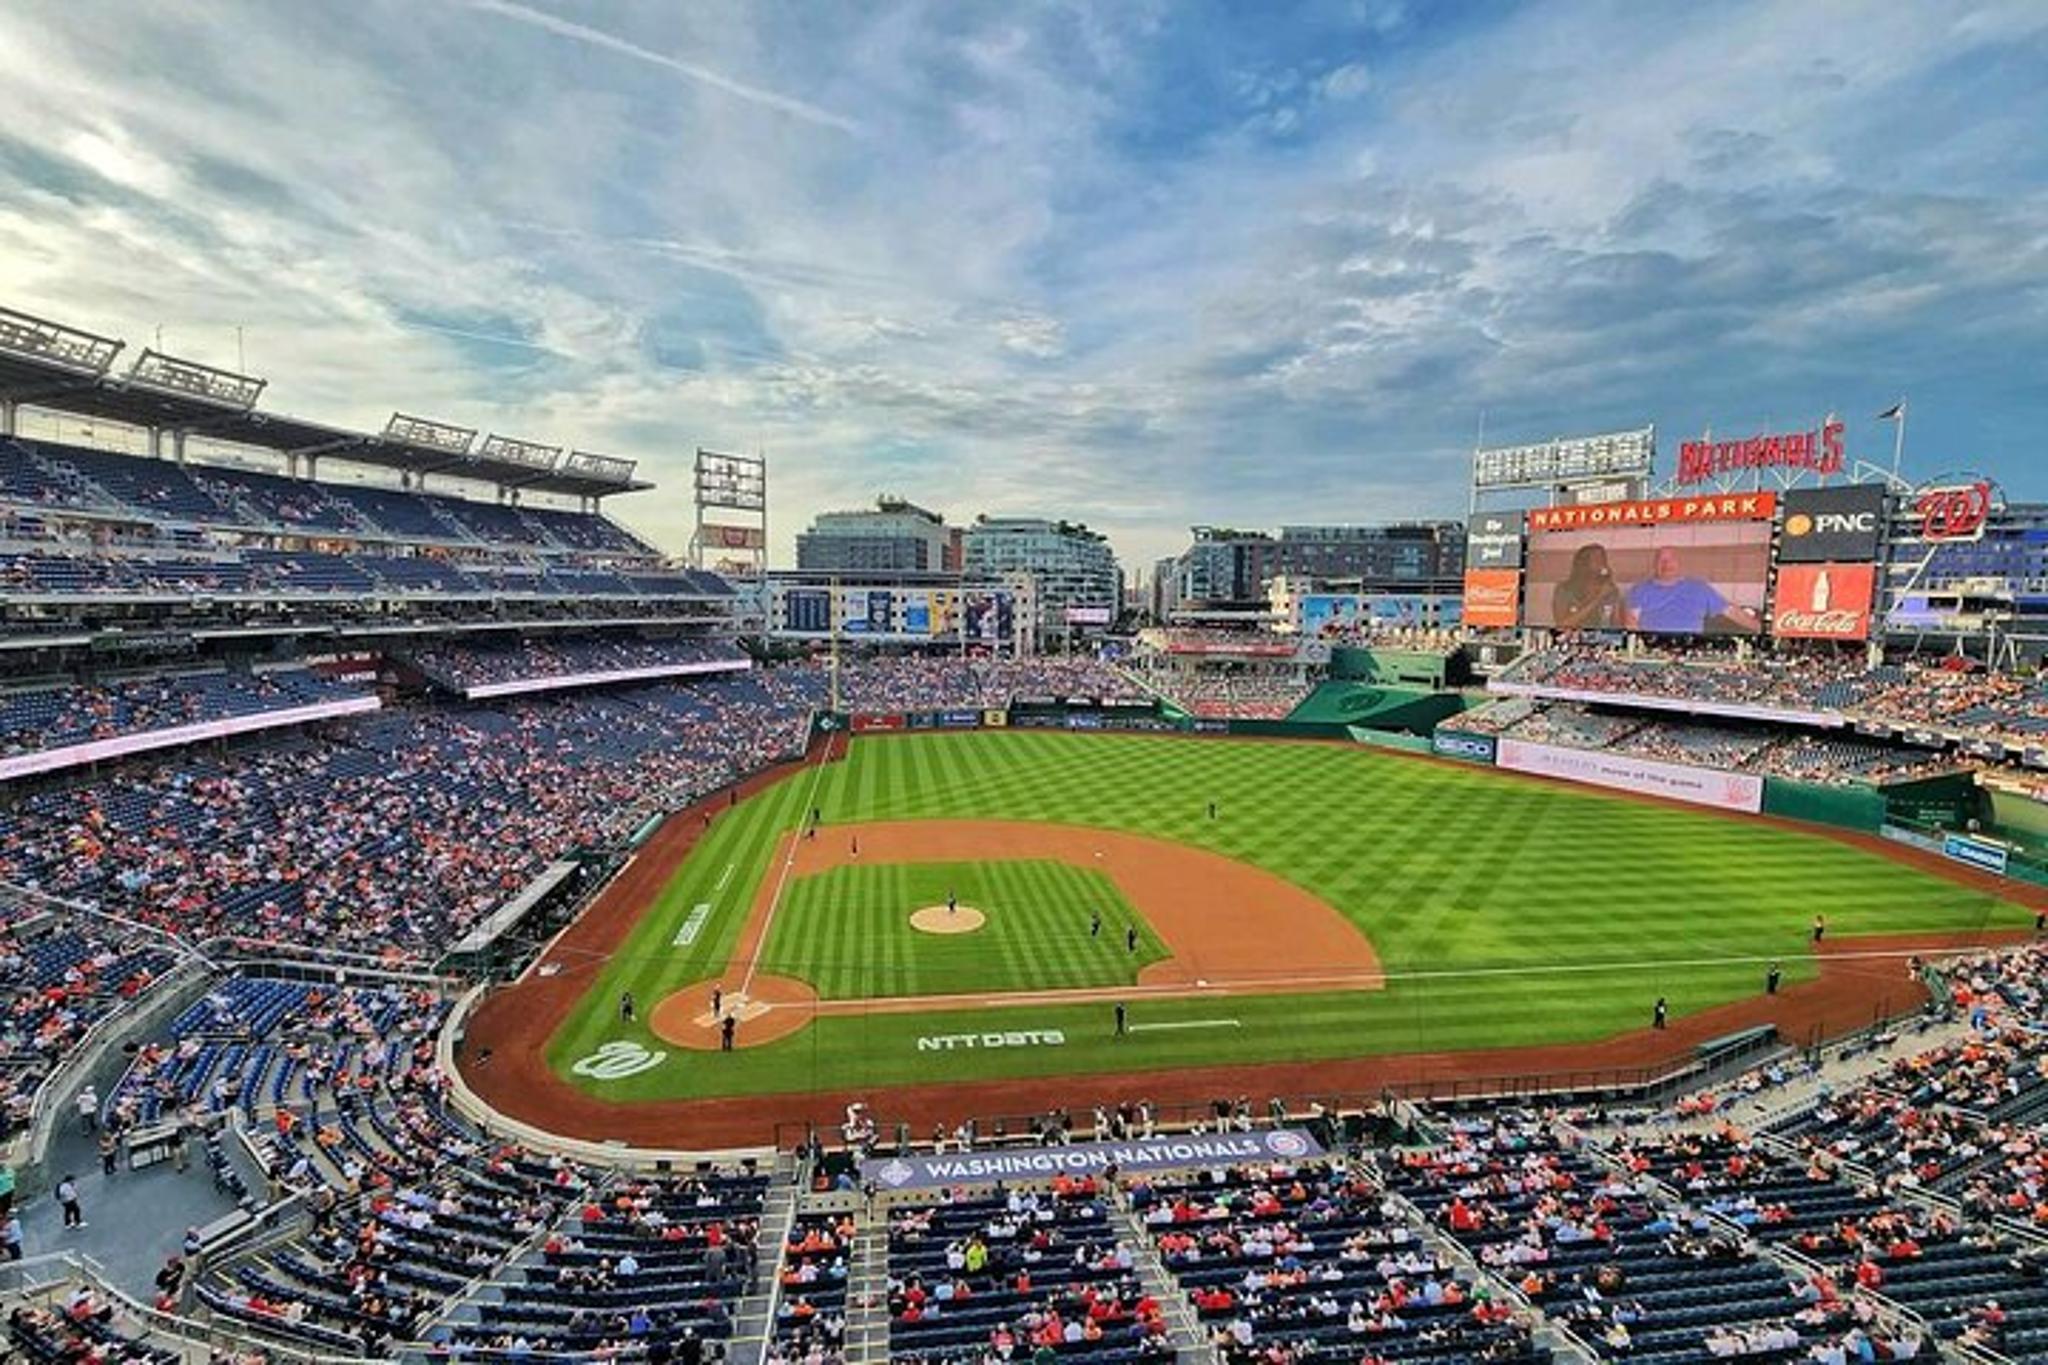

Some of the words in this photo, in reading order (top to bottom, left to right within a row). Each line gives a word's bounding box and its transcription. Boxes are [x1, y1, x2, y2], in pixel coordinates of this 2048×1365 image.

[1678, 422, 1845, 486] NATIONALS
[1535, 502, 1671, 526] NATIONALS
[1685, 497, 1759, 517] PARK
[1815, 512, 1876, 533] PNC
[917, 1035, 979, 1051] NTT
[926, 1150, 1107, 1178] WASHINGTON
[1114, 1139, 1261, 1164] NATIONALS
